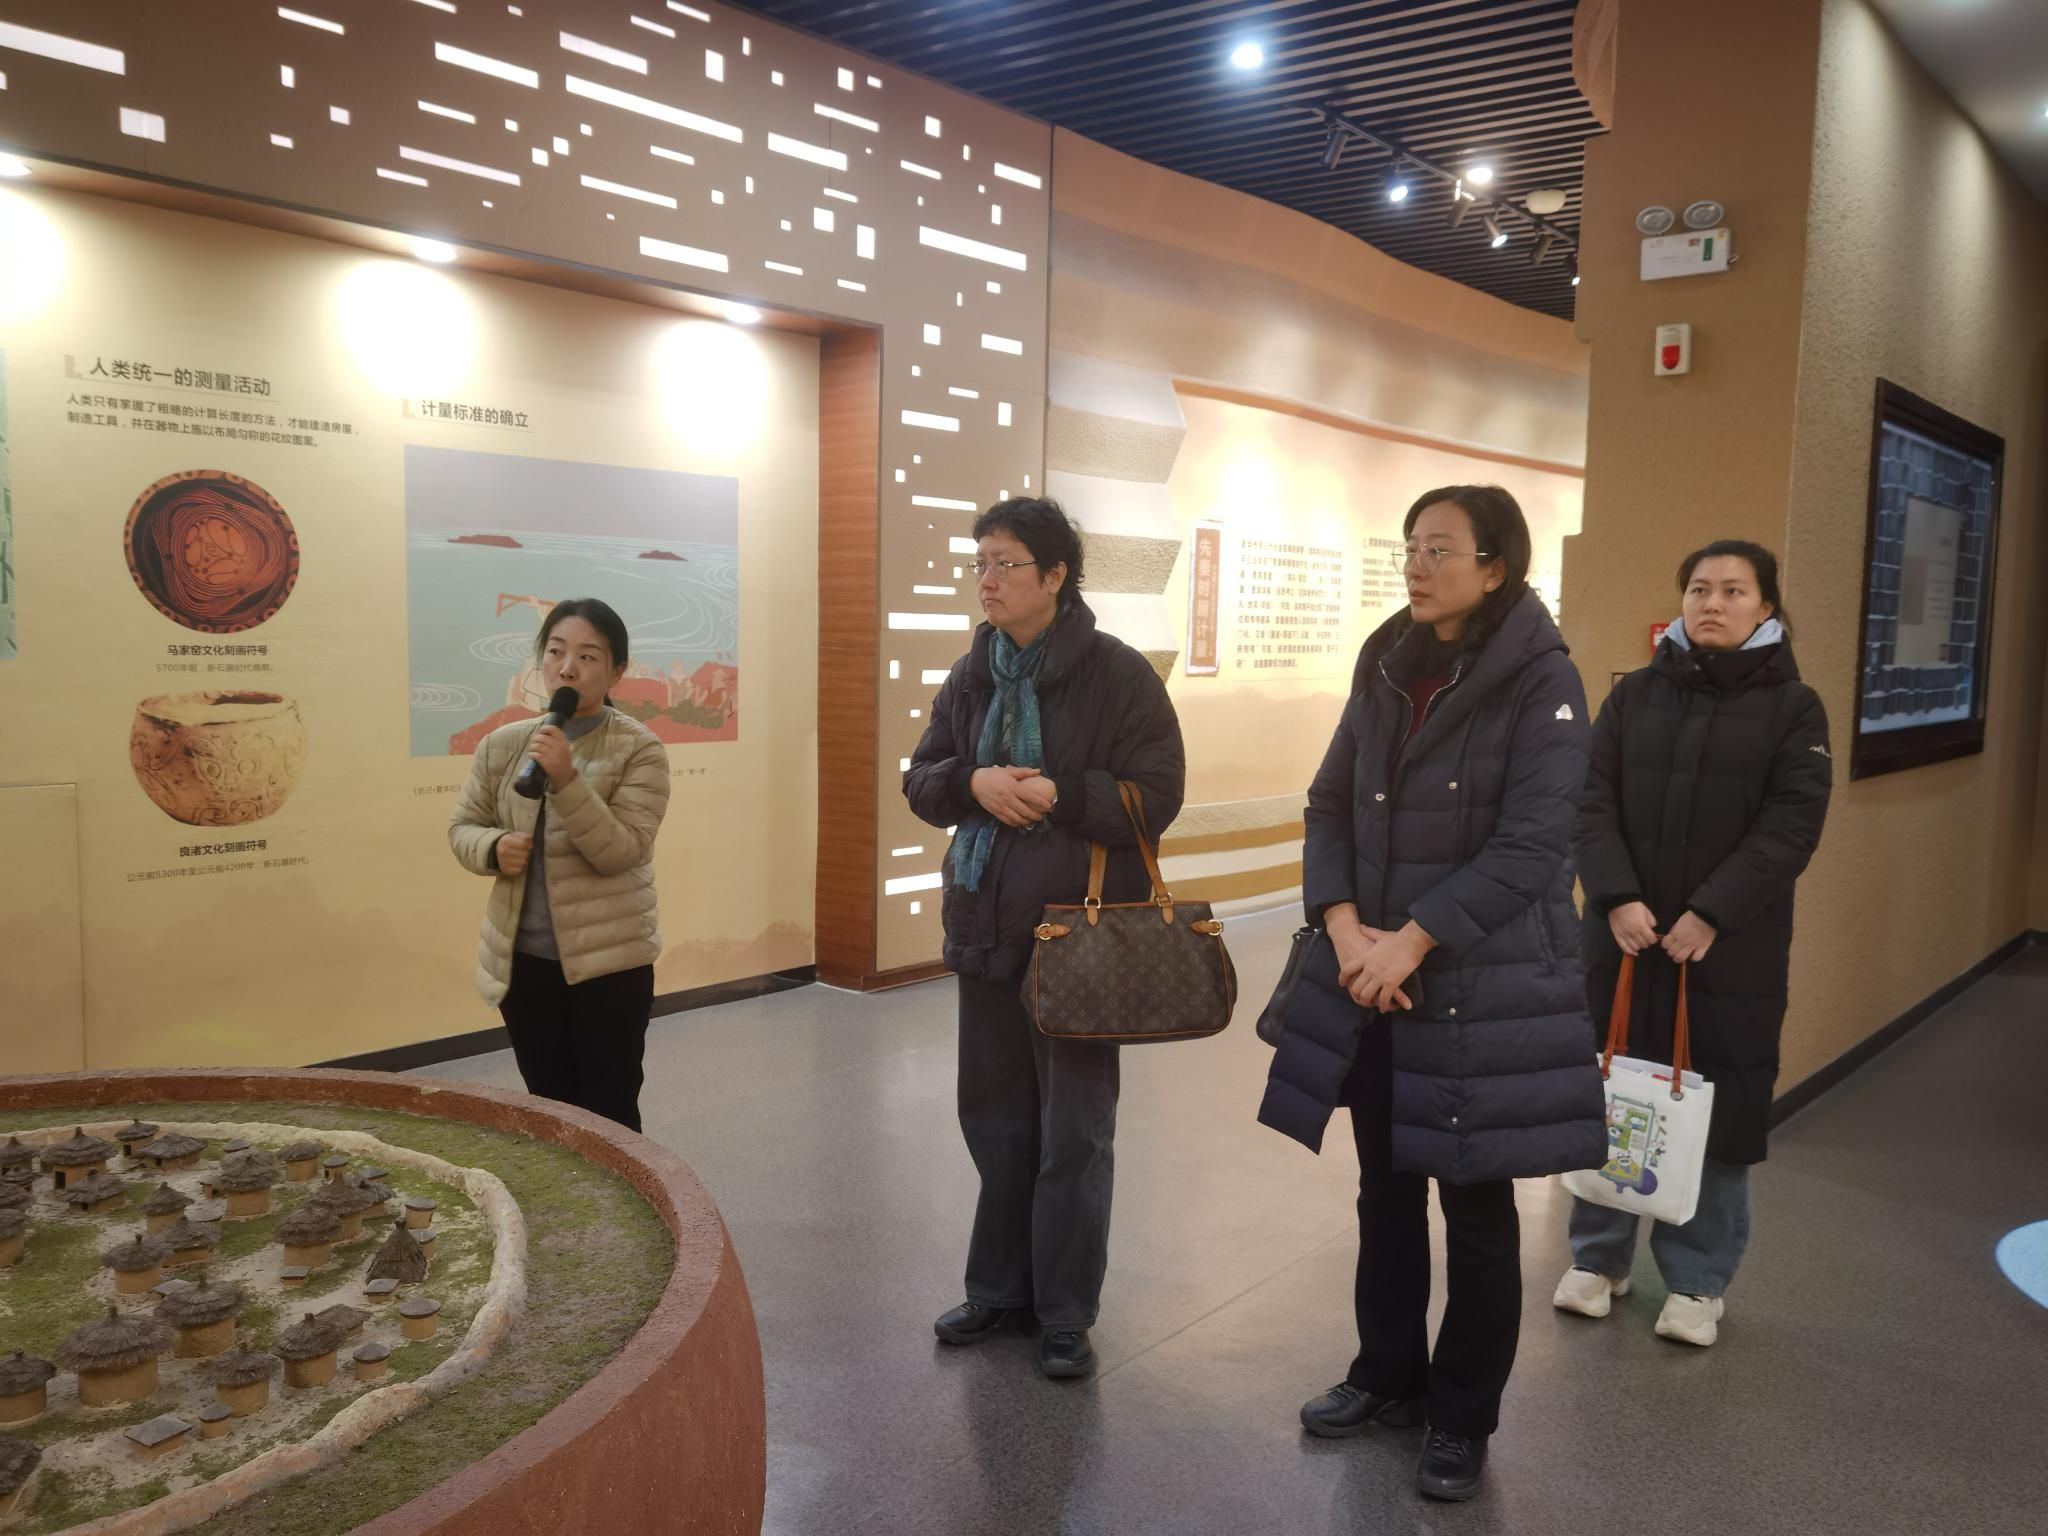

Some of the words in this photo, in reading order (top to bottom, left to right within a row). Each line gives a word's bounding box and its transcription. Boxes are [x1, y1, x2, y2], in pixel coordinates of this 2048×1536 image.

[90, 356, 271, 397] 人类统一的测量活动
[422, 399, 529, 428] 计量标准的确立
[167, 644, 269, 656] 马家窑文化刻画符号
[179, 839, 268, 858] 良渚文化刻画符号
